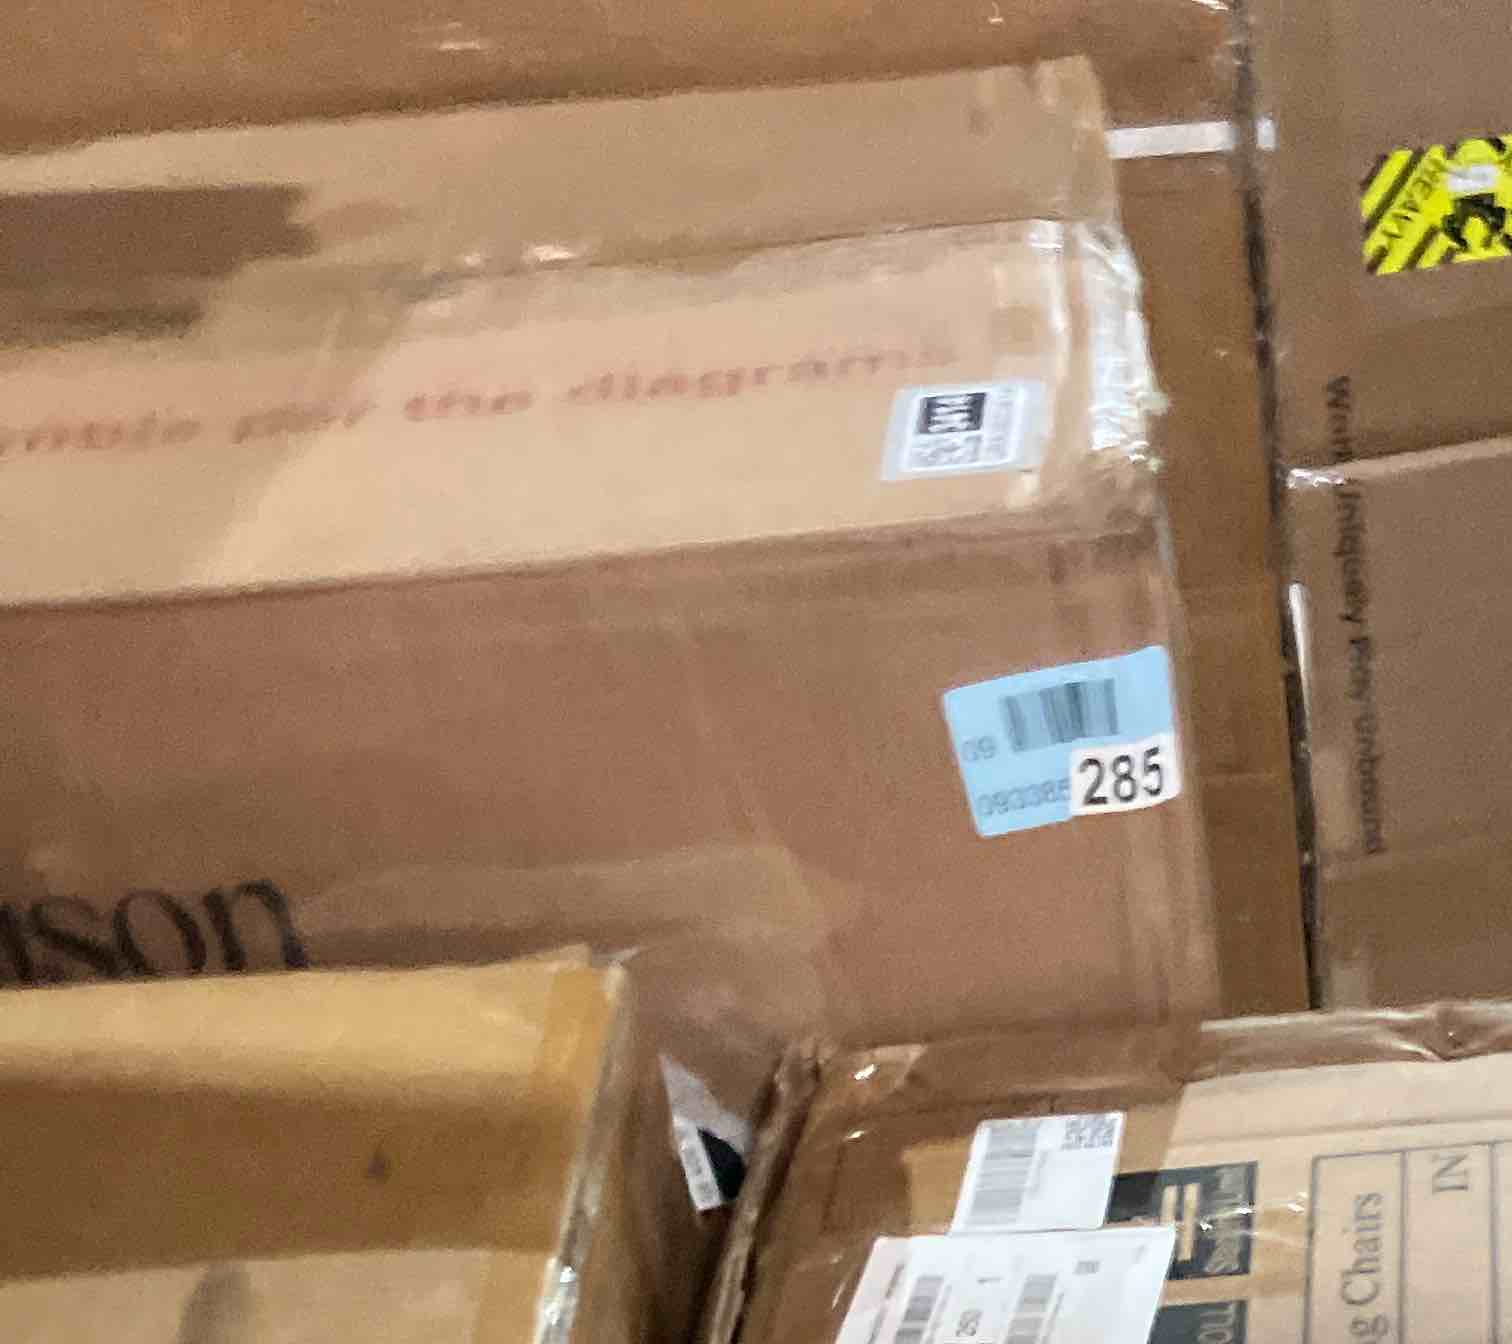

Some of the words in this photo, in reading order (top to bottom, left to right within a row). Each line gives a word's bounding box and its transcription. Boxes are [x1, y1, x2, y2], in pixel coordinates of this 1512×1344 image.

[1077, 745, 1165, 806] 285
[1431, 1150, 1470, 1194] IN
[1341, 1191, 1384, 1304] Chairs
